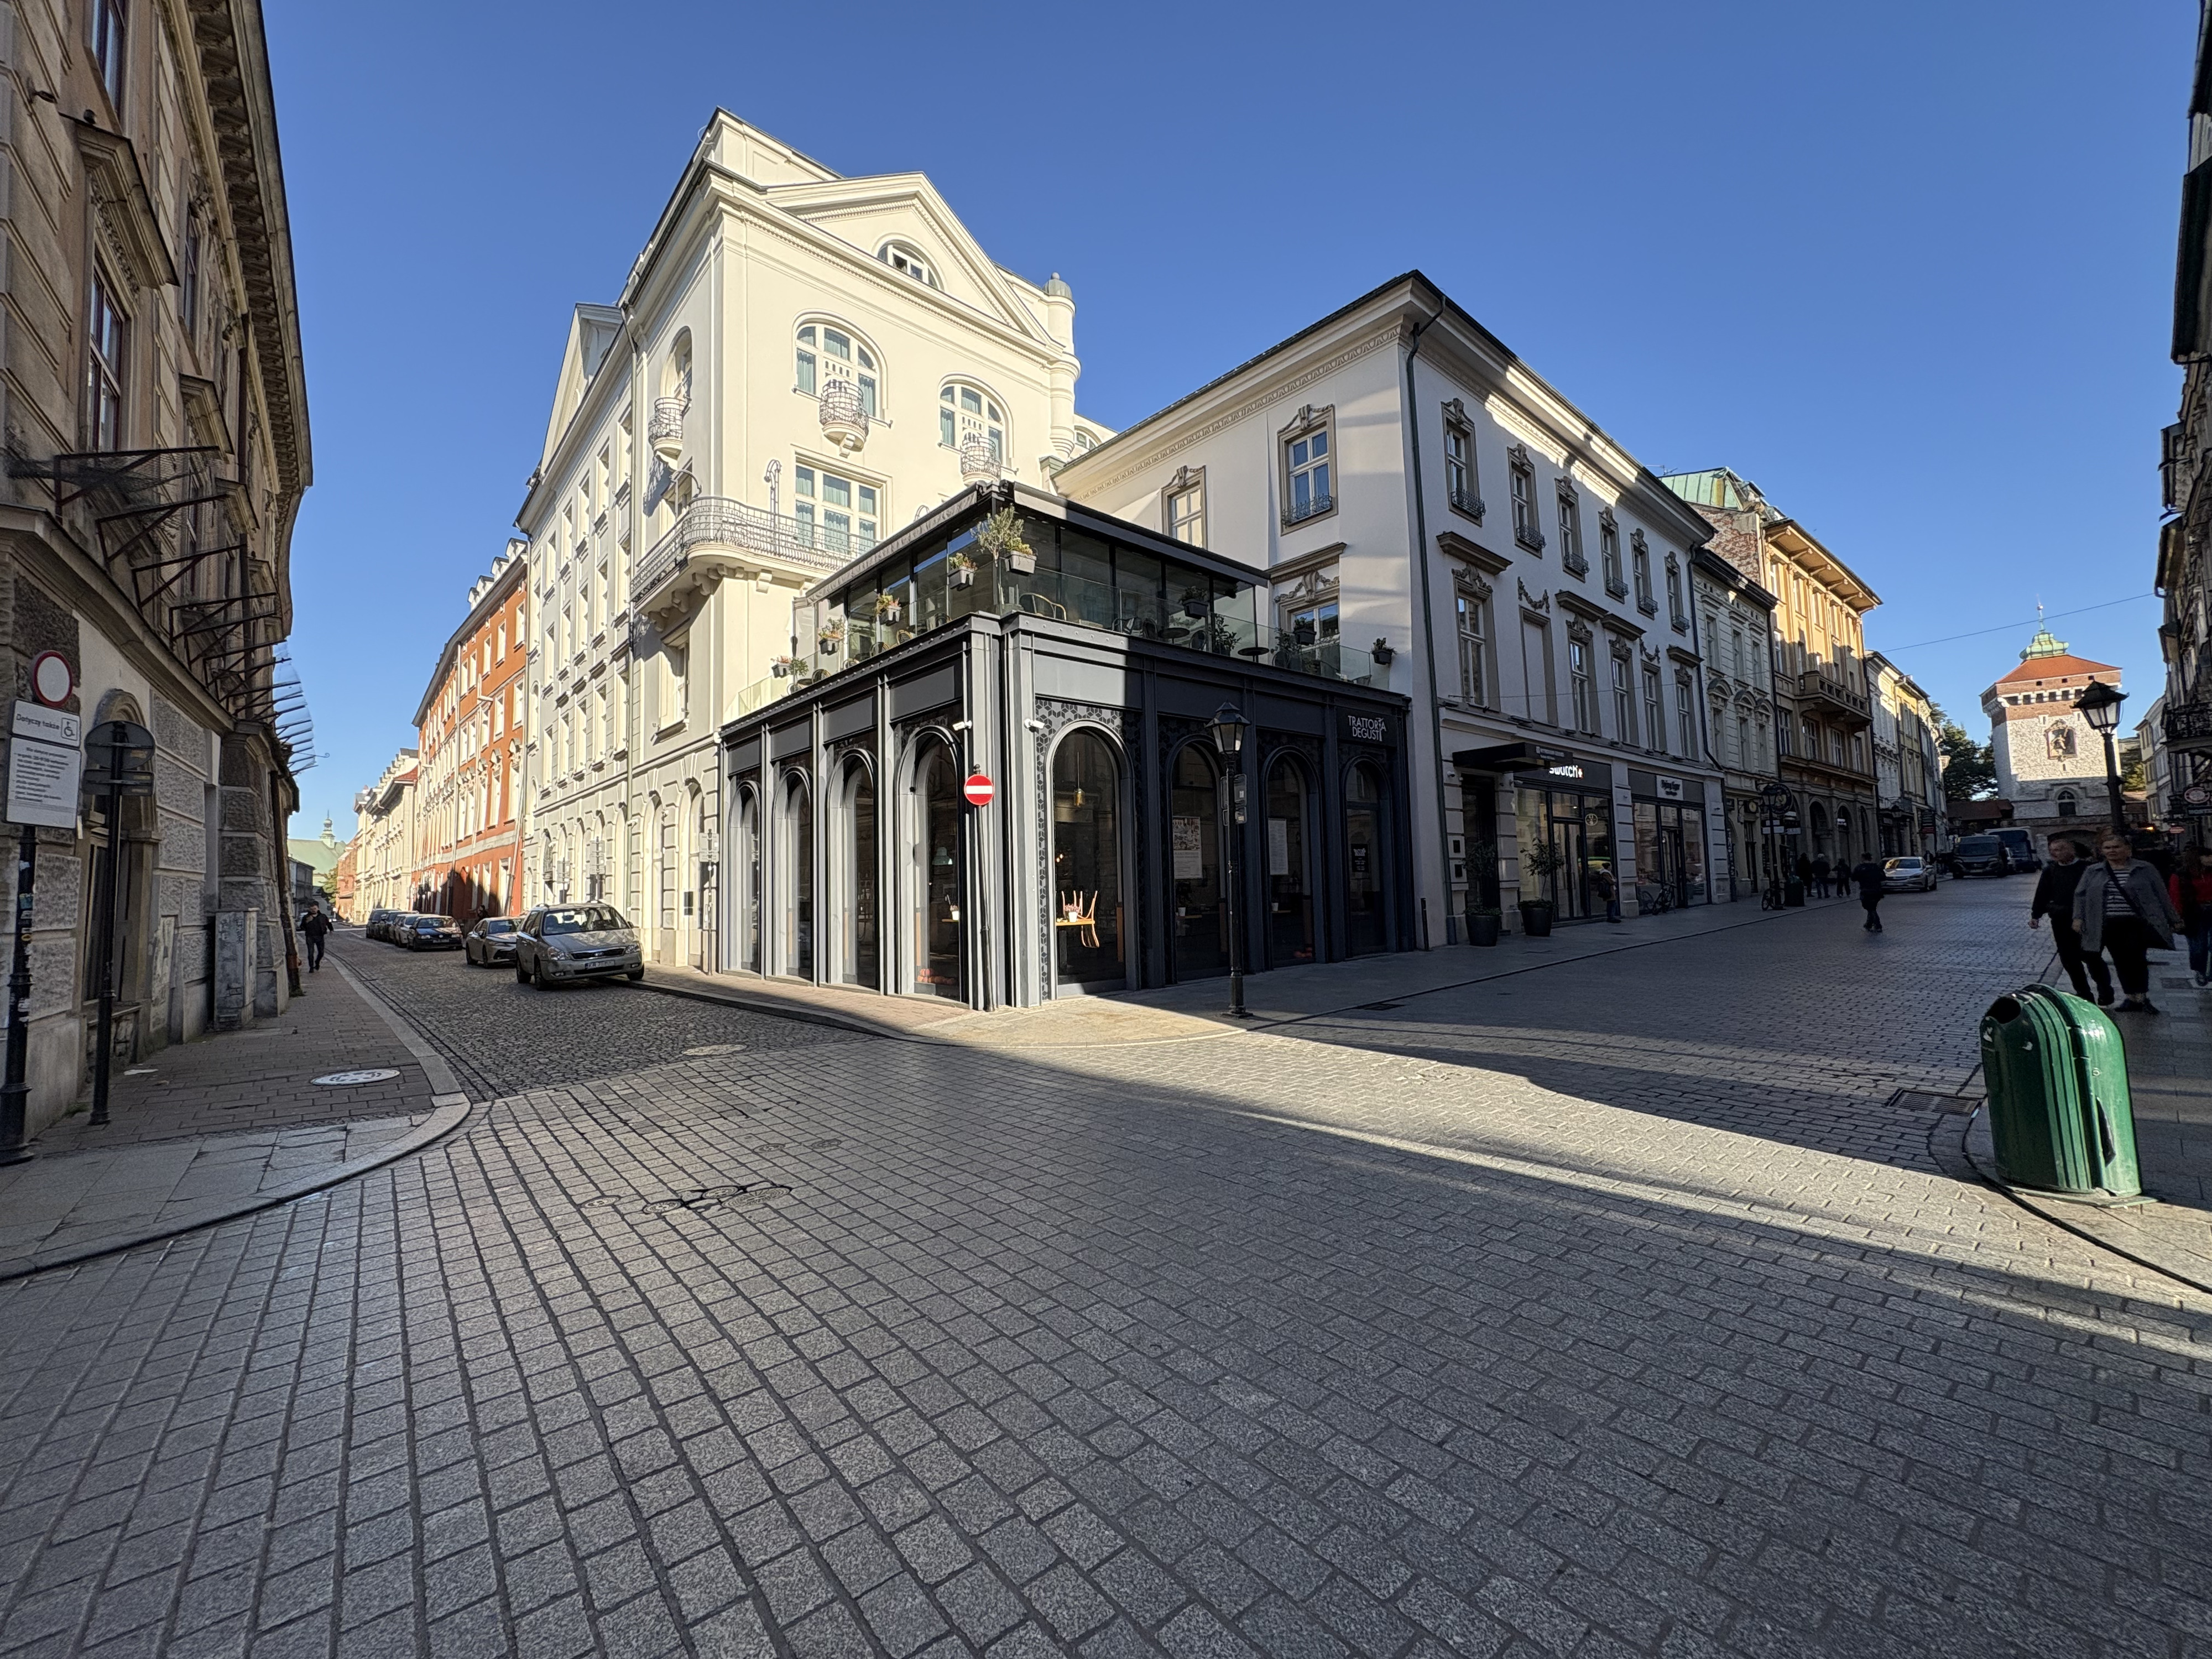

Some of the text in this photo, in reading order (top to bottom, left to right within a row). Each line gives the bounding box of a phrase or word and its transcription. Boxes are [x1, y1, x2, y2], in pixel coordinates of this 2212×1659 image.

[16, 714, 41, 727] Dotyczy
[1348, 715, 1387, 732] TRATTORIA
[1352, 726, 1383, 742] DEGUSTI
